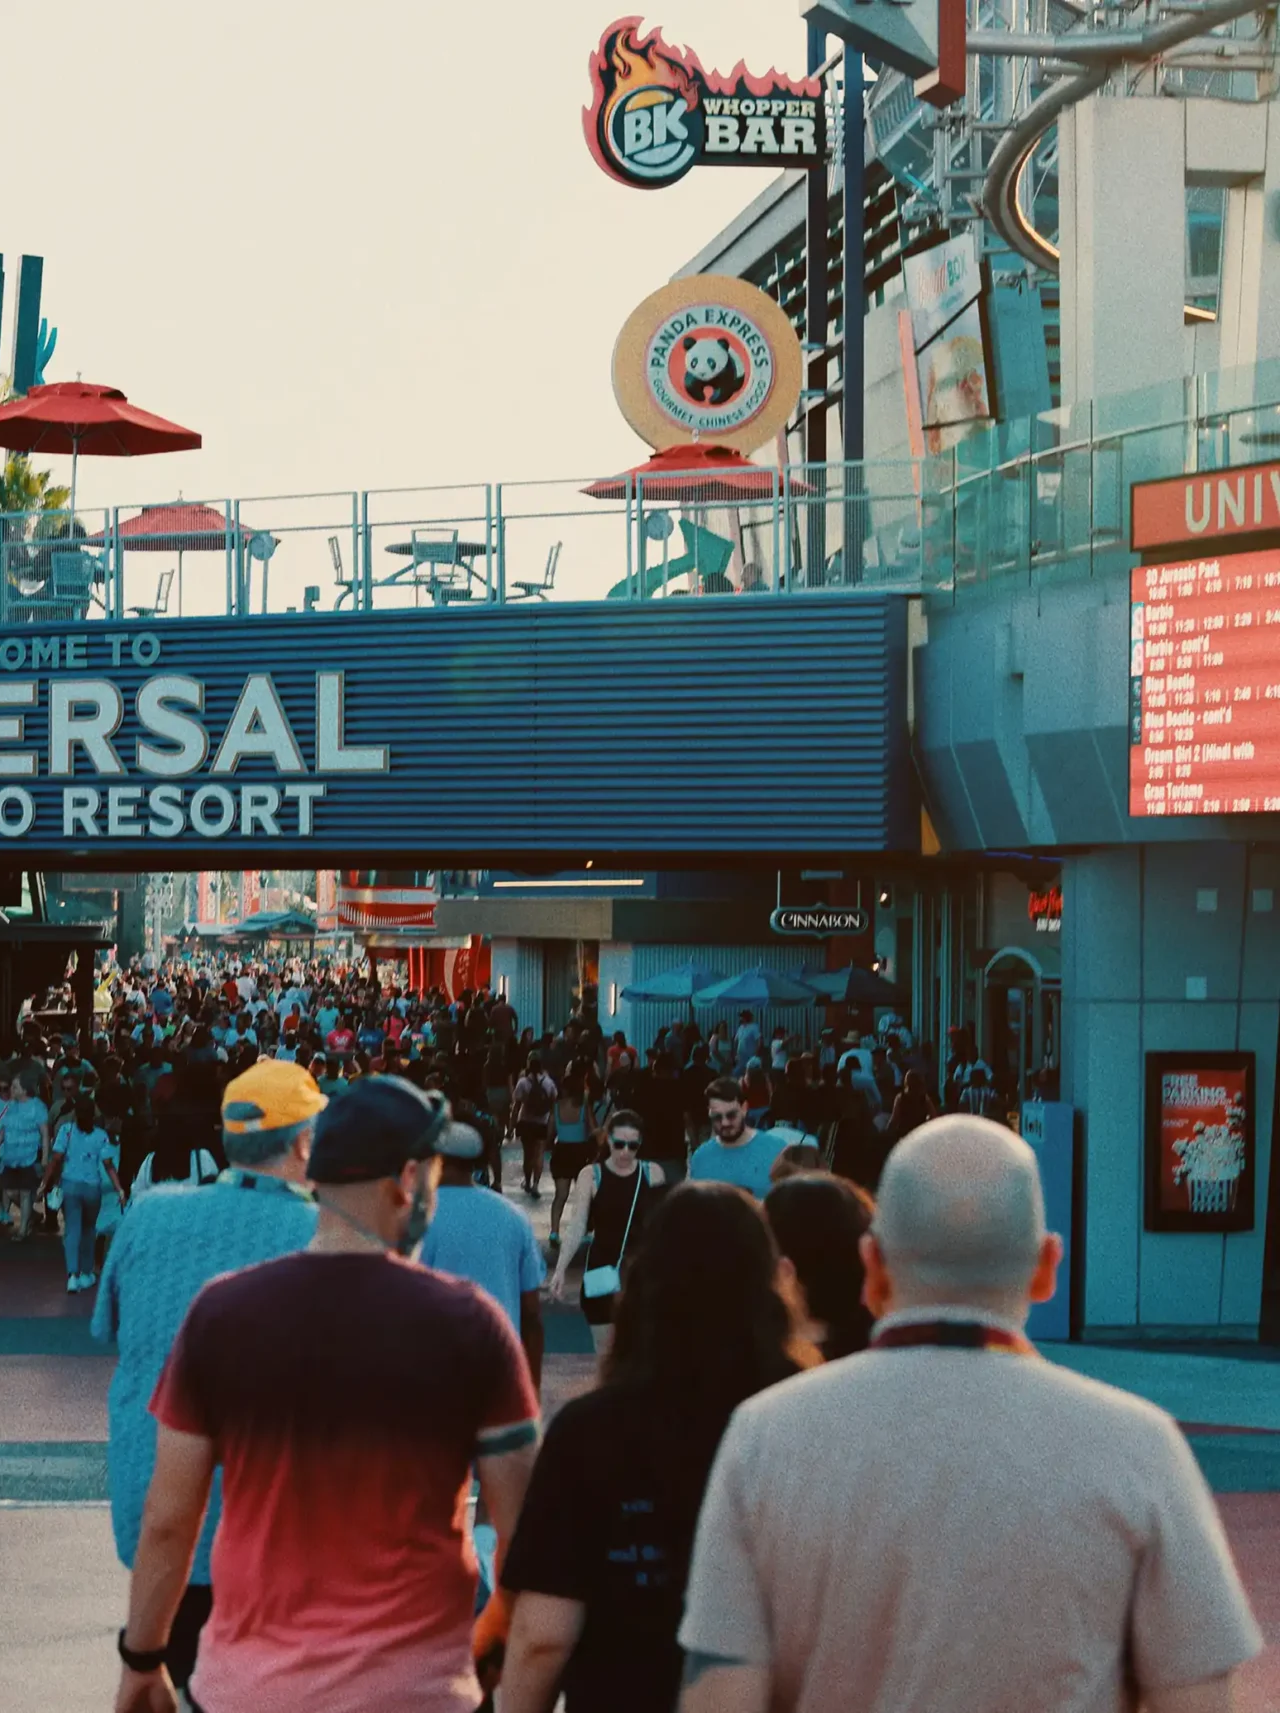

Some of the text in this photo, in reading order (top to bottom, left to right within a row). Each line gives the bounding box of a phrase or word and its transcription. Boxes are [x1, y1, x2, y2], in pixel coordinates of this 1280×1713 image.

[703, 98, 816, 117] WHOPPER
[623, 98, 689, 157] BK
[705, 117, 817, 154] BAR
[650, 308, 769, 368] PANDA EXPRESS
[653, 379, 767, 428] GOURMET CHINESE FOOD
[1198, 560, 1220, 578] Park
[1146, 604, 1174, 622] Barbie
[105, 632, 162, 668] TO
[1145, 711, 1164, 729] Blue
[1144, 747, 1173, 765] Dream
[1194, 744, 1200, 762] 2
[1144, 782, 1203, 801] Gran Turismo
[62, 783, 327, 837] RESORT
[780, 911, 860, 929] CINNABON
[1162, 1074, 1198, 1088] FREE
[1162, 1086, 1227, 1101] PARKING
